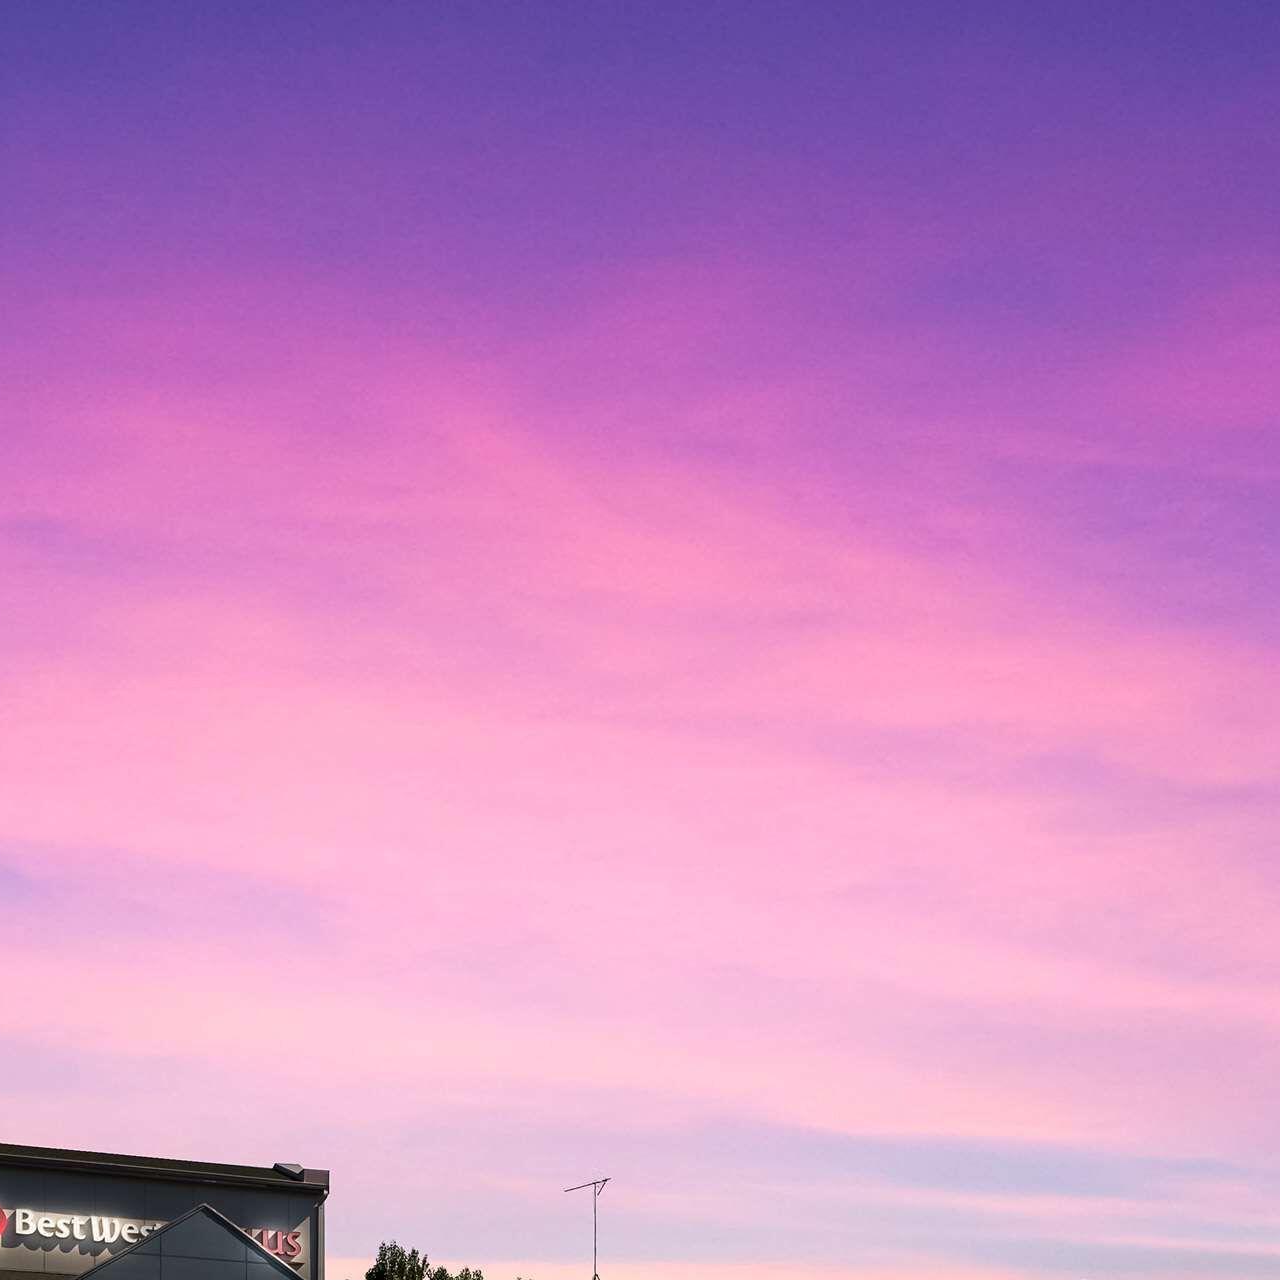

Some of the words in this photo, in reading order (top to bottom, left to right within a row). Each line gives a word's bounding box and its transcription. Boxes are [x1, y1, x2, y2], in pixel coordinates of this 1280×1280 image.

[16, 1209, 86, 1240] Best
[90, 1216, 164, 1244] Wes
[261, 1229, 302, 1257] us
